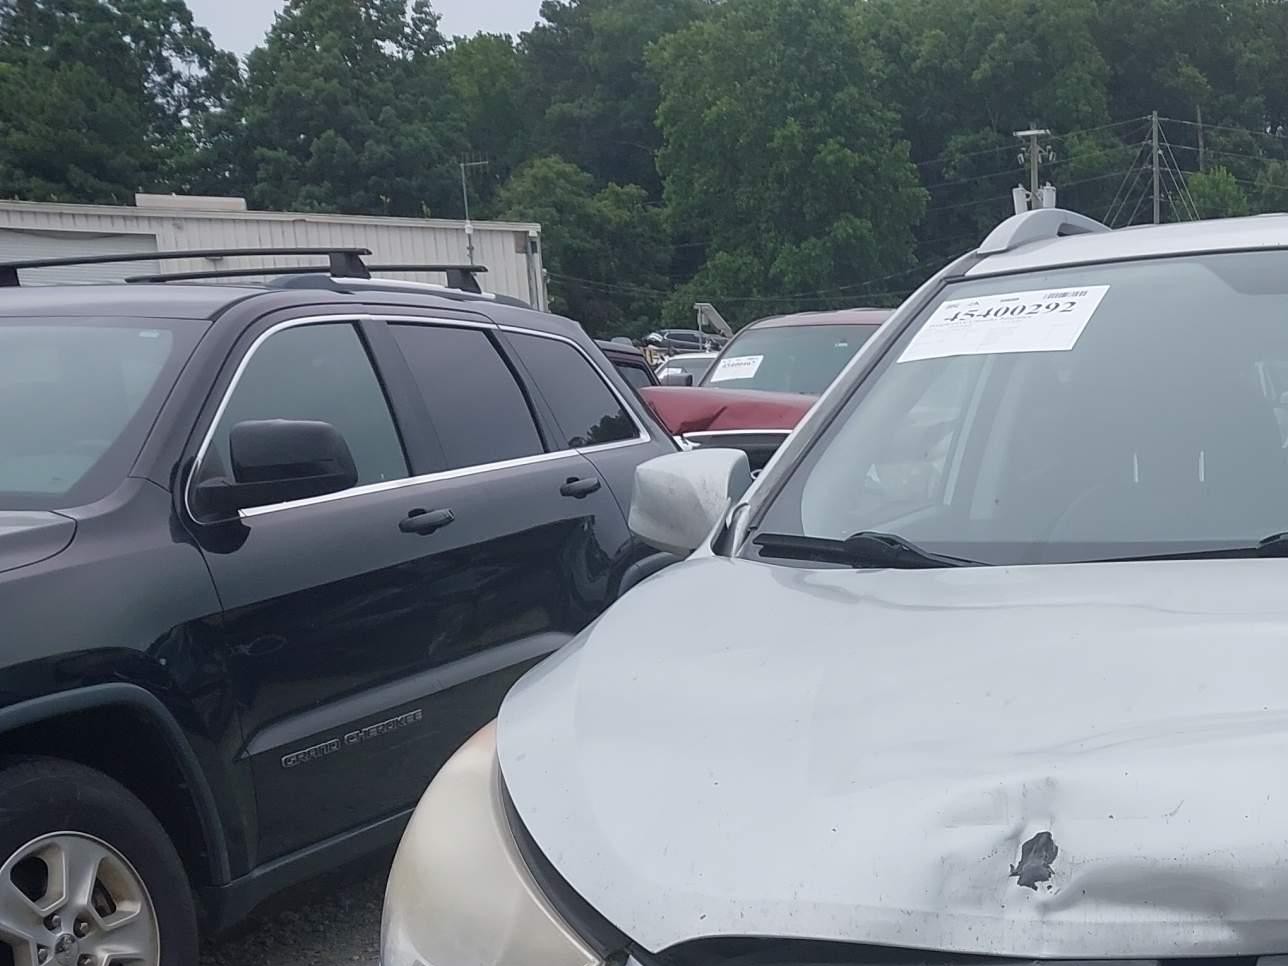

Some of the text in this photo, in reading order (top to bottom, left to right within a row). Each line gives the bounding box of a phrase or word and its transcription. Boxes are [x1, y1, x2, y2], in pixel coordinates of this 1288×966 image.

[944, 301, 1077, 322] 45400292
[281, 708, 423, 768] GRAND CHEROKEE
